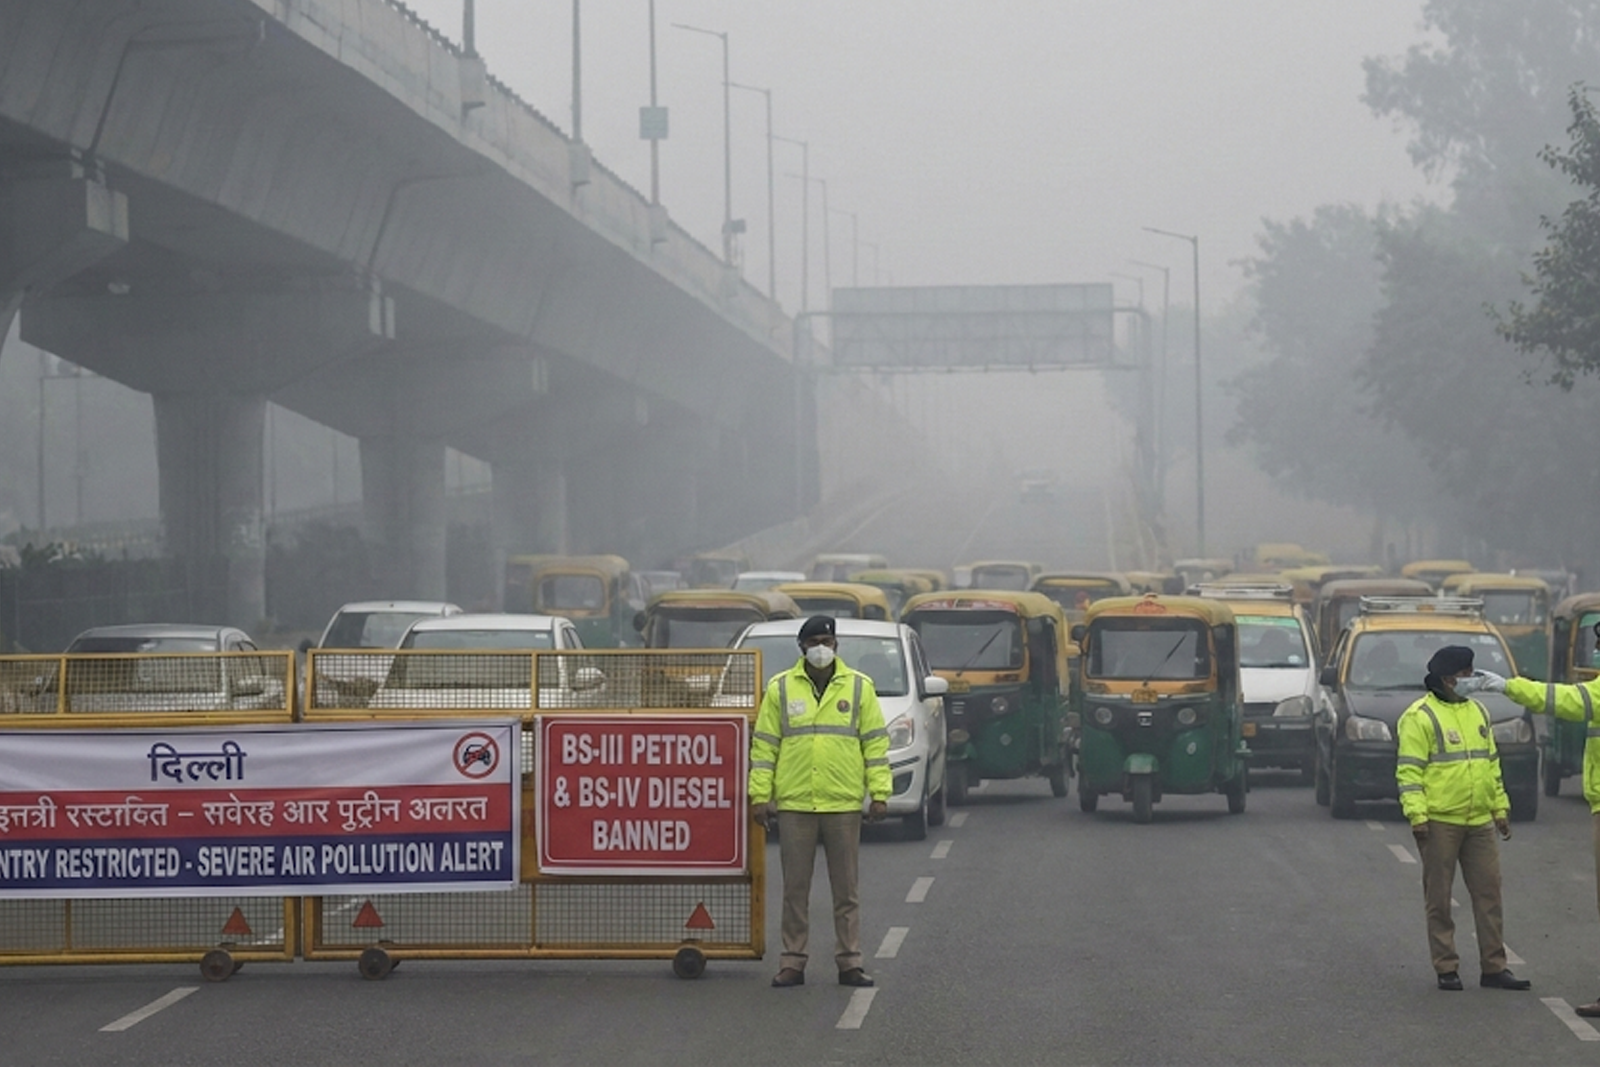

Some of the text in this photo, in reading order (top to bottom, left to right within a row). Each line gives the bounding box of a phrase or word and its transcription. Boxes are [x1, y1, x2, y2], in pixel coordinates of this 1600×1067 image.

[147, 741, 247, 783] दिल्ली
[562, 734, 723, 765] BS-III PETROL
[553, 776, 731, 808] & BS-IV DIESEL
[283, 800, 331, 824] आर
[408, 797, 488, 821] अलरत
[593, 819, 691, 851] BANNED
[55, 848, 180, 878] RESTRICTED
[197, 846, 275, 876] SEVERE
[281, 845, 316, 875] AIR
[321, 842, 434, 875] POLLUTION
[439, 841, 504, 872] ALERT
